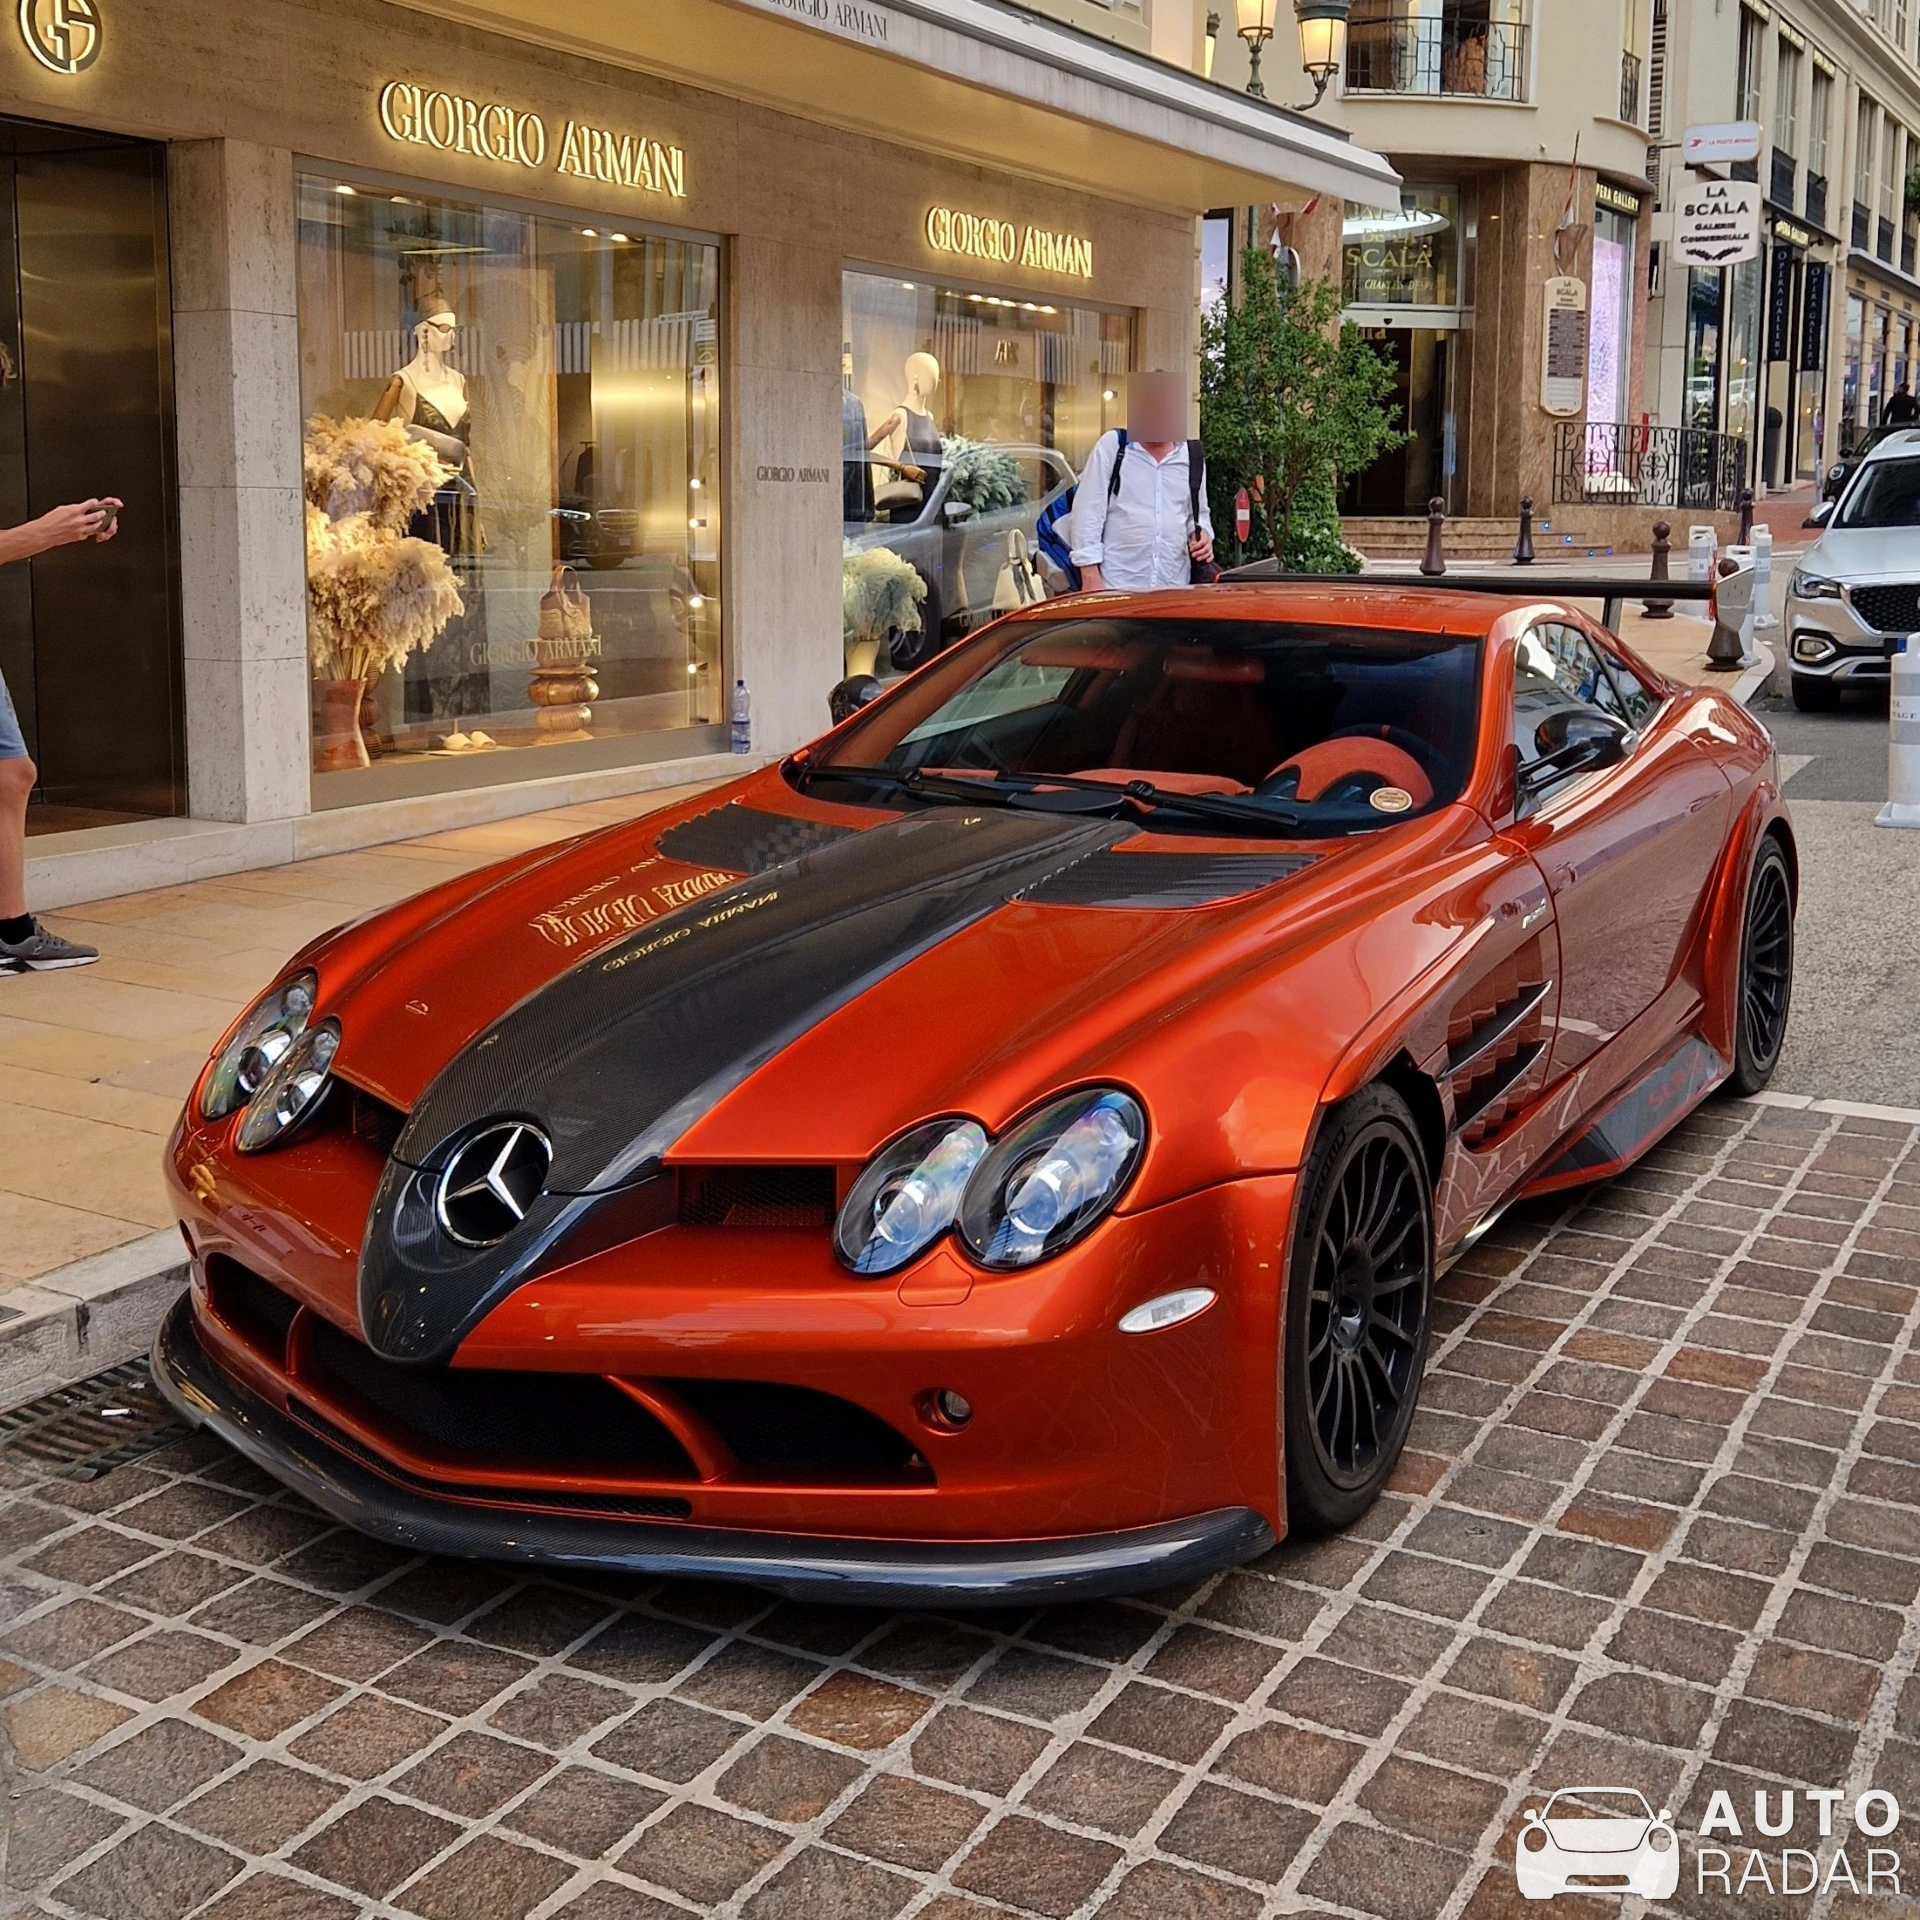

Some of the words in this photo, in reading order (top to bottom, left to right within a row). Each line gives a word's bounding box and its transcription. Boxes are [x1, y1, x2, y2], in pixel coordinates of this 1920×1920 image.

[768, 0, 828, 20] RGIO
[834, 2, 887, 41] ARMANI
[380, 80, 546, 168] GIORGIO
[557, 120, 687, 198] ARMANI
[1596, 183, 1611, 201] PERA
[1613, 190, 1639, 212] GALLERY
[1706, 186, 1727, 198] LA
[1684, 201, 1749, 216] SCALA
[1694, 221, 1736, 231] GALERIE
[926, 206, 1017, 263] GIORGIO
[1020, 226, 1093, 279] ARMANI
[1362, 228, 1385, 243] DE
[1393, 230, 1417, 244] LA
[1680, 232, 1750, 243] COMMERCIALE
[1346, 248, 1433, 268] SCALA
[756, 465, 795, 482] GIORGIO
[797, 467, 830, 483] ARMANI
[470, 641, 538, 665] GIORGIO
[543, 634, 602, 660] ARMANI
